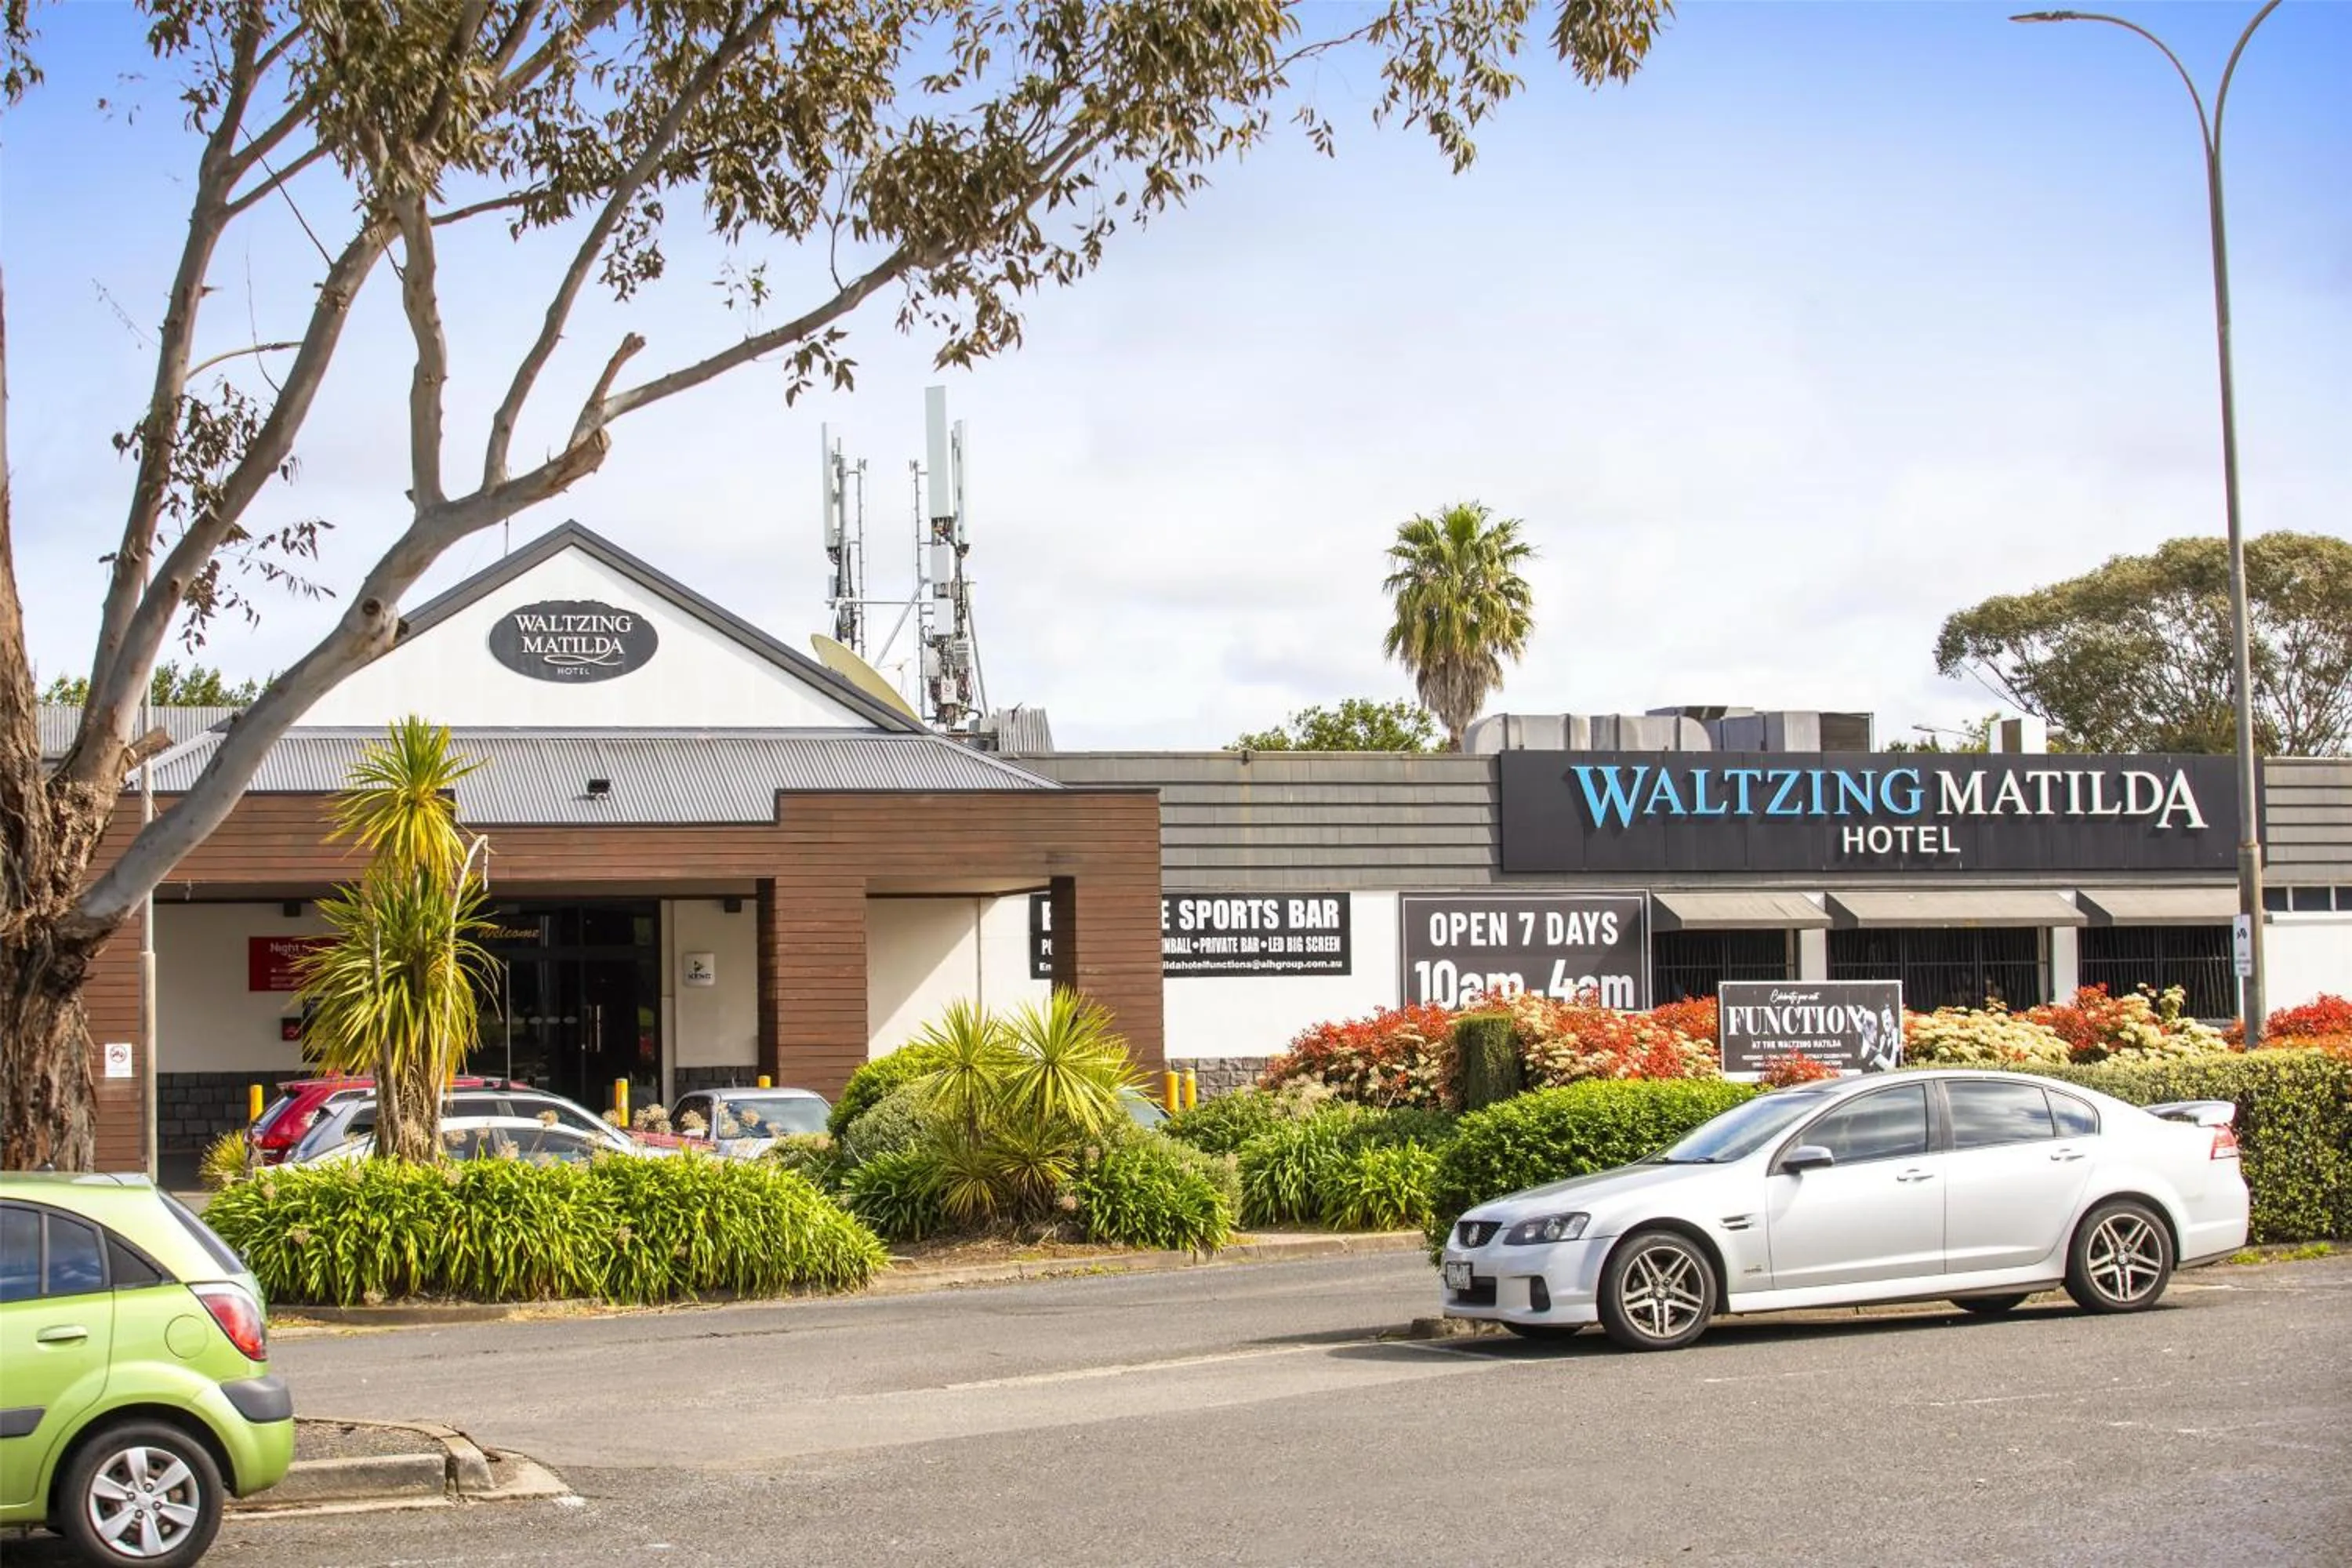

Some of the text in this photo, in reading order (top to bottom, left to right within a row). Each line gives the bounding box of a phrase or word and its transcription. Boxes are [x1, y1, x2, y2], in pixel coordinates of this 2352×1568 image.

[514, 614, 633, 633] WALTZING
[522, 636, 625, 655] MATILDA
[1570, 765, 2209, 829] WALTZING MATILDA
[1842, 826, 1960, 854] HOTEL
[1178, 899, 1279, 929] SPORTS
[1289, 899, 1340, 928] BAR
[1429, 912, 1618, 946] OPEN 7 DAYS
[1200, 937, 1238, 953] PRIVATE
[1240, 936, 1260, 953] BAR
[1268, 936, 1284, 953] LED
[1287, 936, 1303, 953] BIG
[1305, 936, 1341, 953] SCREEN
[1727, 1005, 1863, 1036] FUNCTION
